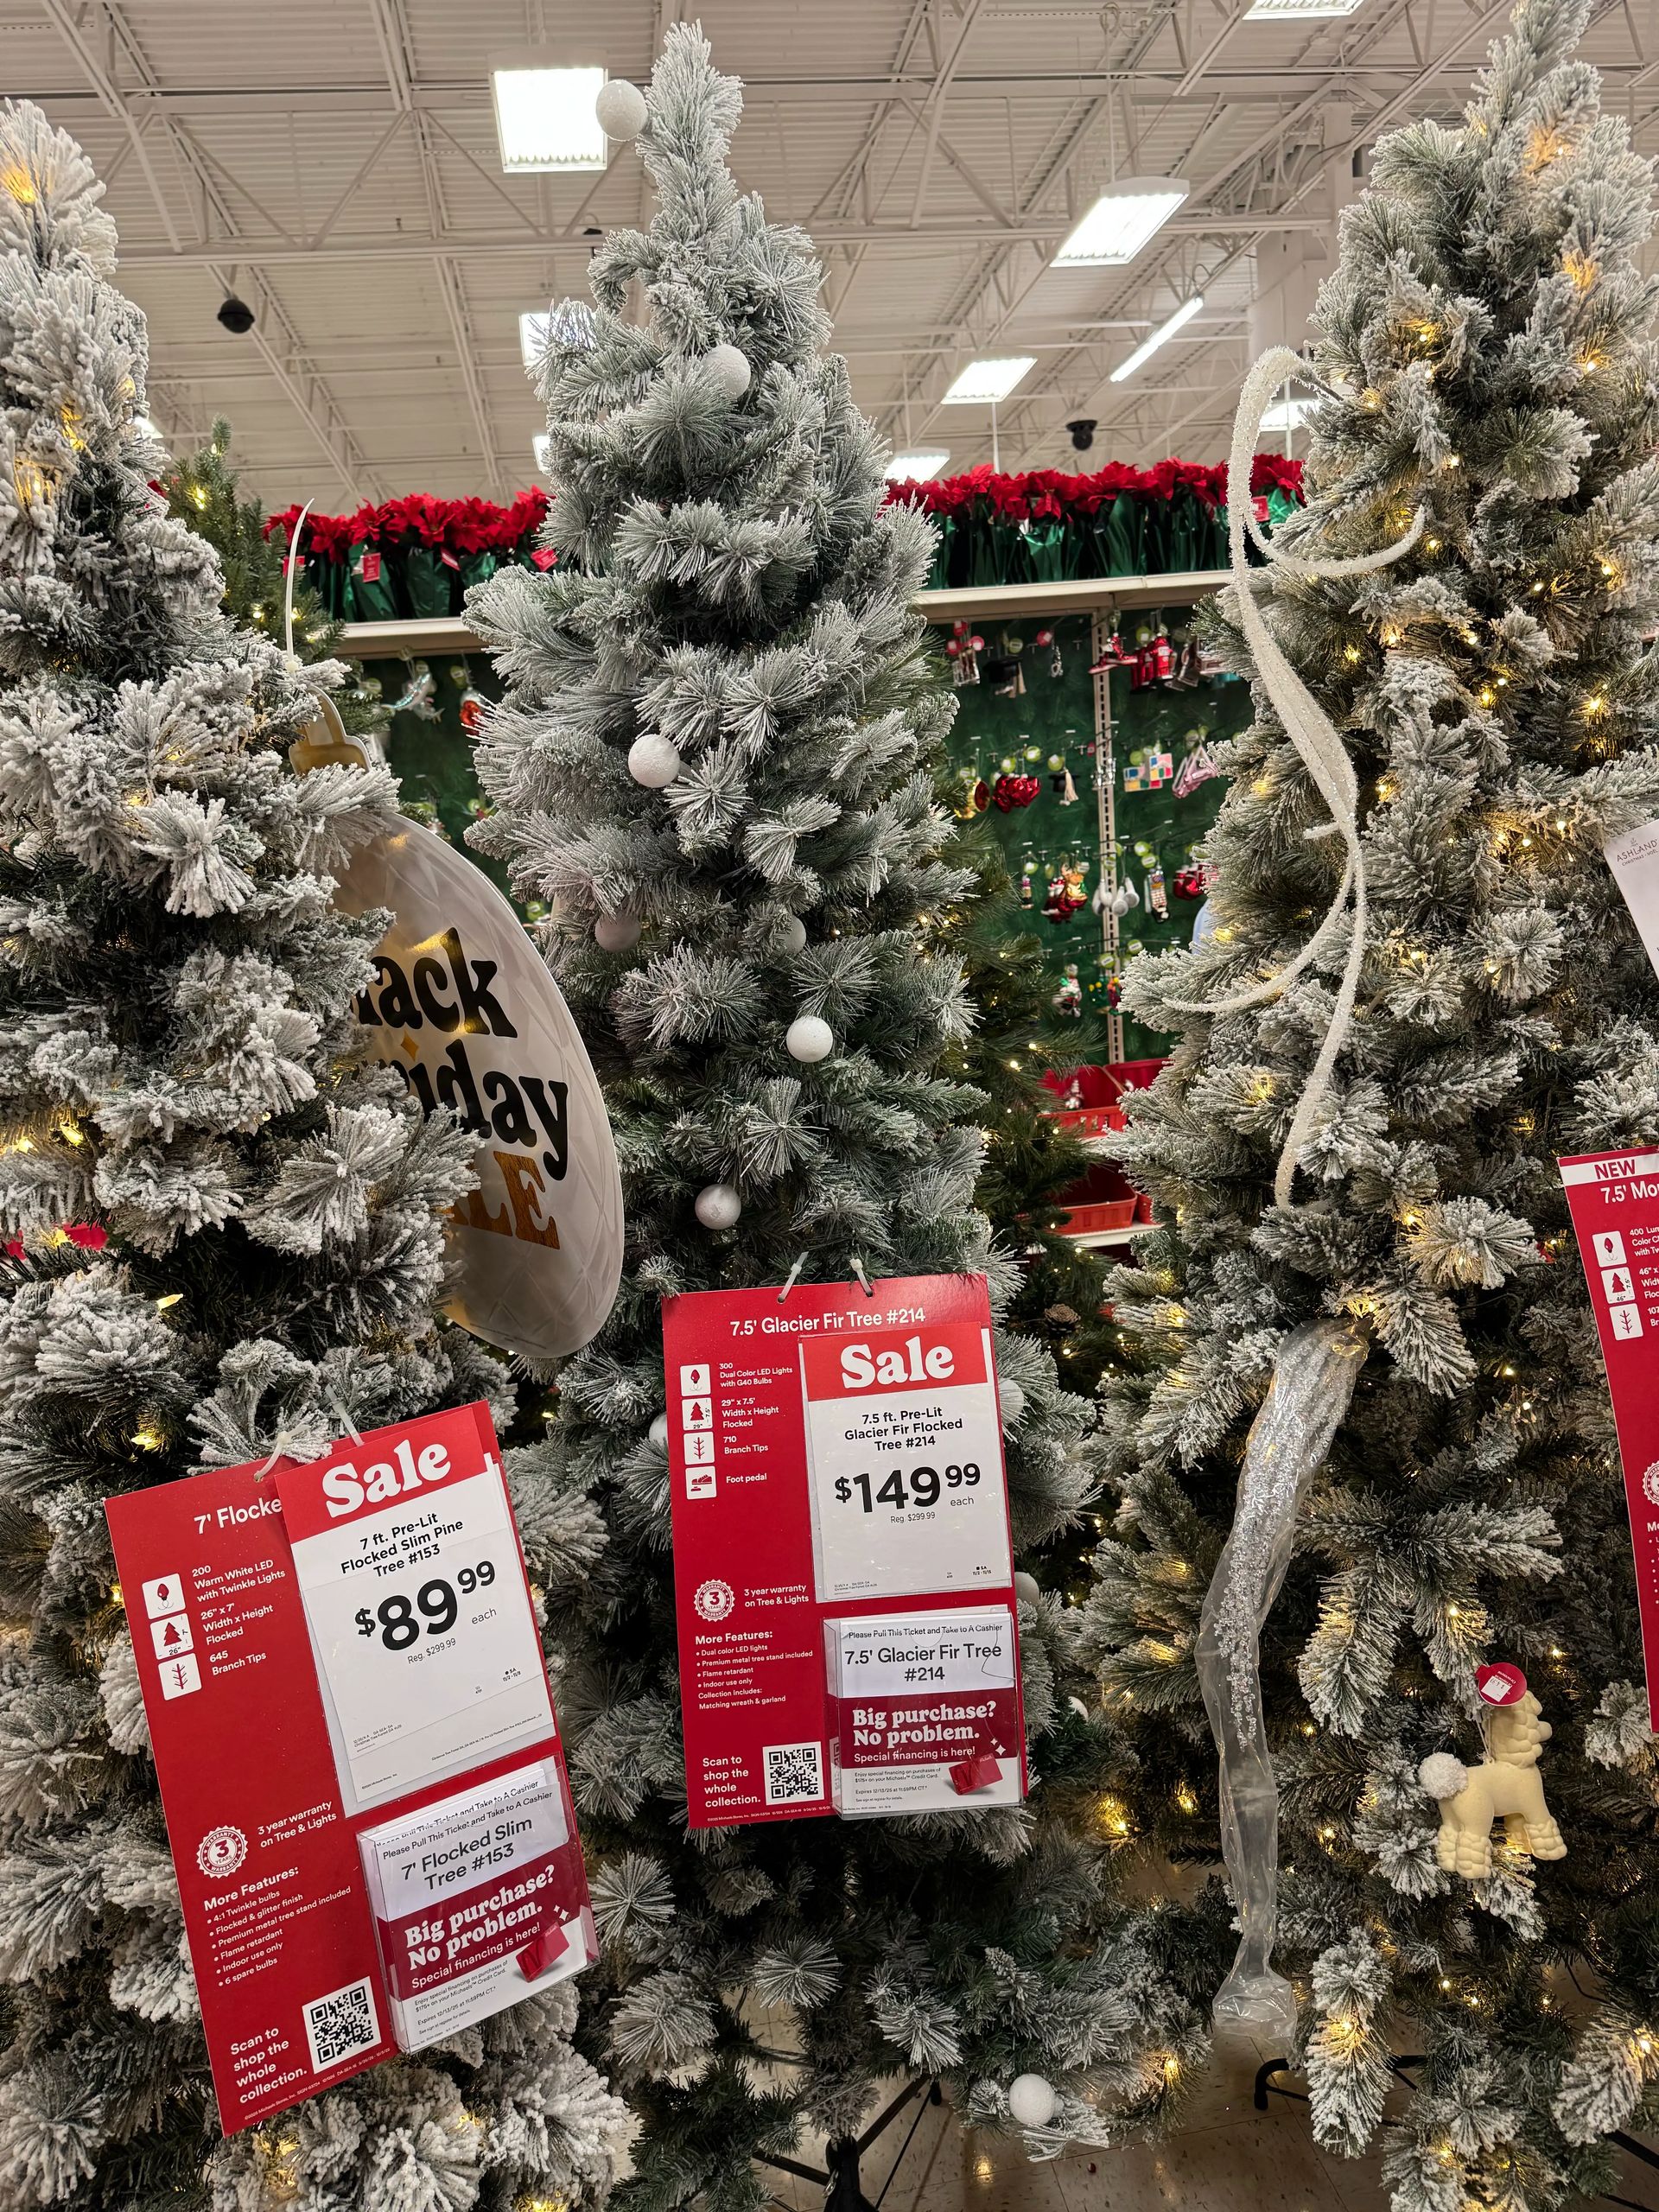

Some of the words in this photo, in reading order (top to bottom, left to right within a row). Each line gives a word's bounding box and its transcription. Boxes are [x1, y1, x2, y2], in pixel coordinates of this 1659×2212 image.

[1617, 840, 1657, 861] ASHLAND
[350, 927, 518, 1038] ack
[385, 1039, 568, 1181] iday
[1593, 1159, 1636, 1179] NEW
[444, 1151, 561, 1250] LE
[1600, 1185, 1626, 1204] 7.5'
[1630, 1180, 1659, 1199] Mo
[1632, 1237, 1650, 1246] Color
[730, 1319, 757, 1336] 7.5'
[761, 1316, 819, 1333] Glacier
[823, 1313, 844, 1329] Fir
[846, 1311, 882, 1327] Tree
[886, 1306, 926, 1325] #214
[840, 1336, 955, 1389] Sale
[844, 1427, 888, 1440] Glacier
[892, 1424, 909, 1435] Fir
[912, 1418, 963, 1433] Flocked
[861, 1413, 880, 1425] 7.5
[883, 1412, 897, 1422] ft.
[899, 1407, 943, 1421] Pre-Lit
[724, 1445, 751, 1454] Branch
[752, 1444, 768, 1452] Tips
[874, 1440, 902, 1451] Tree
[906, 1434, 936, 1448] #214
[321, 1439, 451, 1518] Sale
[745, 1472, 767, 1483] pedal
[950, 1496, 974, 1507] each
[194, 1513, 211, 1534] 7'
[907, 1511, 935, 1522] $299.99
[359, 1537, 368, 1550] 7
[372, 1533, 389, 1545] ft.
[391, 1513, 438, 1538] Pre-Lit
[340, 1542, 397, 1574] Flocked
[400, 1533, 430, 1551] Slim
[433, 1521, 463, 1538] Pine
[372, 1560, 404, 1577] Tree
[408, 1543, 440, 1565] #153
[192, 1565, 211, 1577] 200
[194, 1576, 224, 1589] Warm
[224, 1567, 253, 1580] White
[254, 1559, 273, 1572] LED
[196, 1589, 219, 1602] with
[219, 1579, 256, 1595] Twinkle
[257, 1570, 285, 1584] Lights
[200, 1608, 217, 1620] 26"
[226, 1602, 234, 1611] 7'
[202, 1617, 233, 1632] Width
[241, 1604, 273, 1620] Height
[471, 1608, 497, 1624] each
[206, 1625, 244, 1645] Flocked
[695, 1635, 722, 1645] More
[725, 1630, 772, 1642] Features:
[209, 1649, 228, 1662] 645
[212, 1658, 245, 1675] Branch
[245, 1652, 266, 1663] Tips
[407, 1653, 425, 1664] Reg.
[425, 1637, 456, 1656] $299.99
[844, 1649, 873, 1665] 7.5'
[877, 1645, 936, 1662] Glacier
[939, 1643, 960, 1659] Fir
[963, 1643, 1001, 1658] Tree
[904, 1666, 945, 1681] #214
[852, 1707, 887, 1730] Big
[891, 1700, 996, 1728] purchase?
[853, 1729, 881, 1745] No
[887, 1723, 980, 1749] problem.
[702, 1758, 728, 1767] Scan
[730, 1756, 742, 1764] to
[854, 1751, 890, 1764] Special
[892, 1749, 938, 1760] financing
[940, 1748, 948, 1757] is
[950, 1745, 976, 1758] here!
[703, 1770, 729, 1781] shop
[731, 1768, 748, 1778] the
[704, 1783, 737, 1794] whole
[705, 1795, 760, 1808] collection.
[257, 1825, 264, 1835] 3
[265, 1818, 288, 1834] year
[288, 1801, 332, 1823] warranty
[260, 1838, 273, 1847] on
[273, 1828, 296, 1841] Tree
[297, 1823, 306, 1834] &
[307, 1813, 337, 1829] Lights
[383, 1846, 410, 1859] Please
[411, 1837, 427, 1849] Pull
[428, 1831, 444, 1842] This
[471, 1814, 486, 1827] and
[486, 1808, 505, 1818] Take
[522, 1792, 552, 1805] Cashier
[401, 1861, 416, 1880] 7'
[422, 1829, 491, 1872] Flocked
[494, 1819, 532, 1840] Slim
[423, 1866, 467, 1890] Tree
[471, 1842, 514, 1872] #153
[203, 1891, 238, 1911] More
[240, 1866, 299, 1896] Features:
[213, 1912, 225, 1922] 4:1
[226, 1900, 257, 1916] Twinkle
[257, 1891, 280, 1904] bulbs
[215, 1915, 248, 1935] Flocked
[257, 1903, 280, 1919] glitter
[282, 1893, 303, 1907] finish
[218, 1928, 254, 1947] Premium
[255, 1916, 277, 1932] metal
[278, 1910, 295, 1922] tree
[296, 1899, 317, 1915] stand
[318, 1885, 351, 1905] included
[404, 1919, 445, 1948] Big
[448, 1864, 555, 1936] purchase?
[407, 1946, 441, 1970] No
[445, 1901, 543, 1960] problem.
[411, 1963, 452, 1988] Special
[454, 1942, 503, 1970] financing
[505, 1937, 513, 1947] is
[515, 1921, 540, 1942] here!
[230, 2035, 263, 2055] Scan
[264, 2028, 279, 2039] to
[233, 2051, 265, 2071] shop
[267, 2040, 289, 2055] the
[236, 2063, 276, 2088] whole
[239, 2068, 307, 2103] collection.
